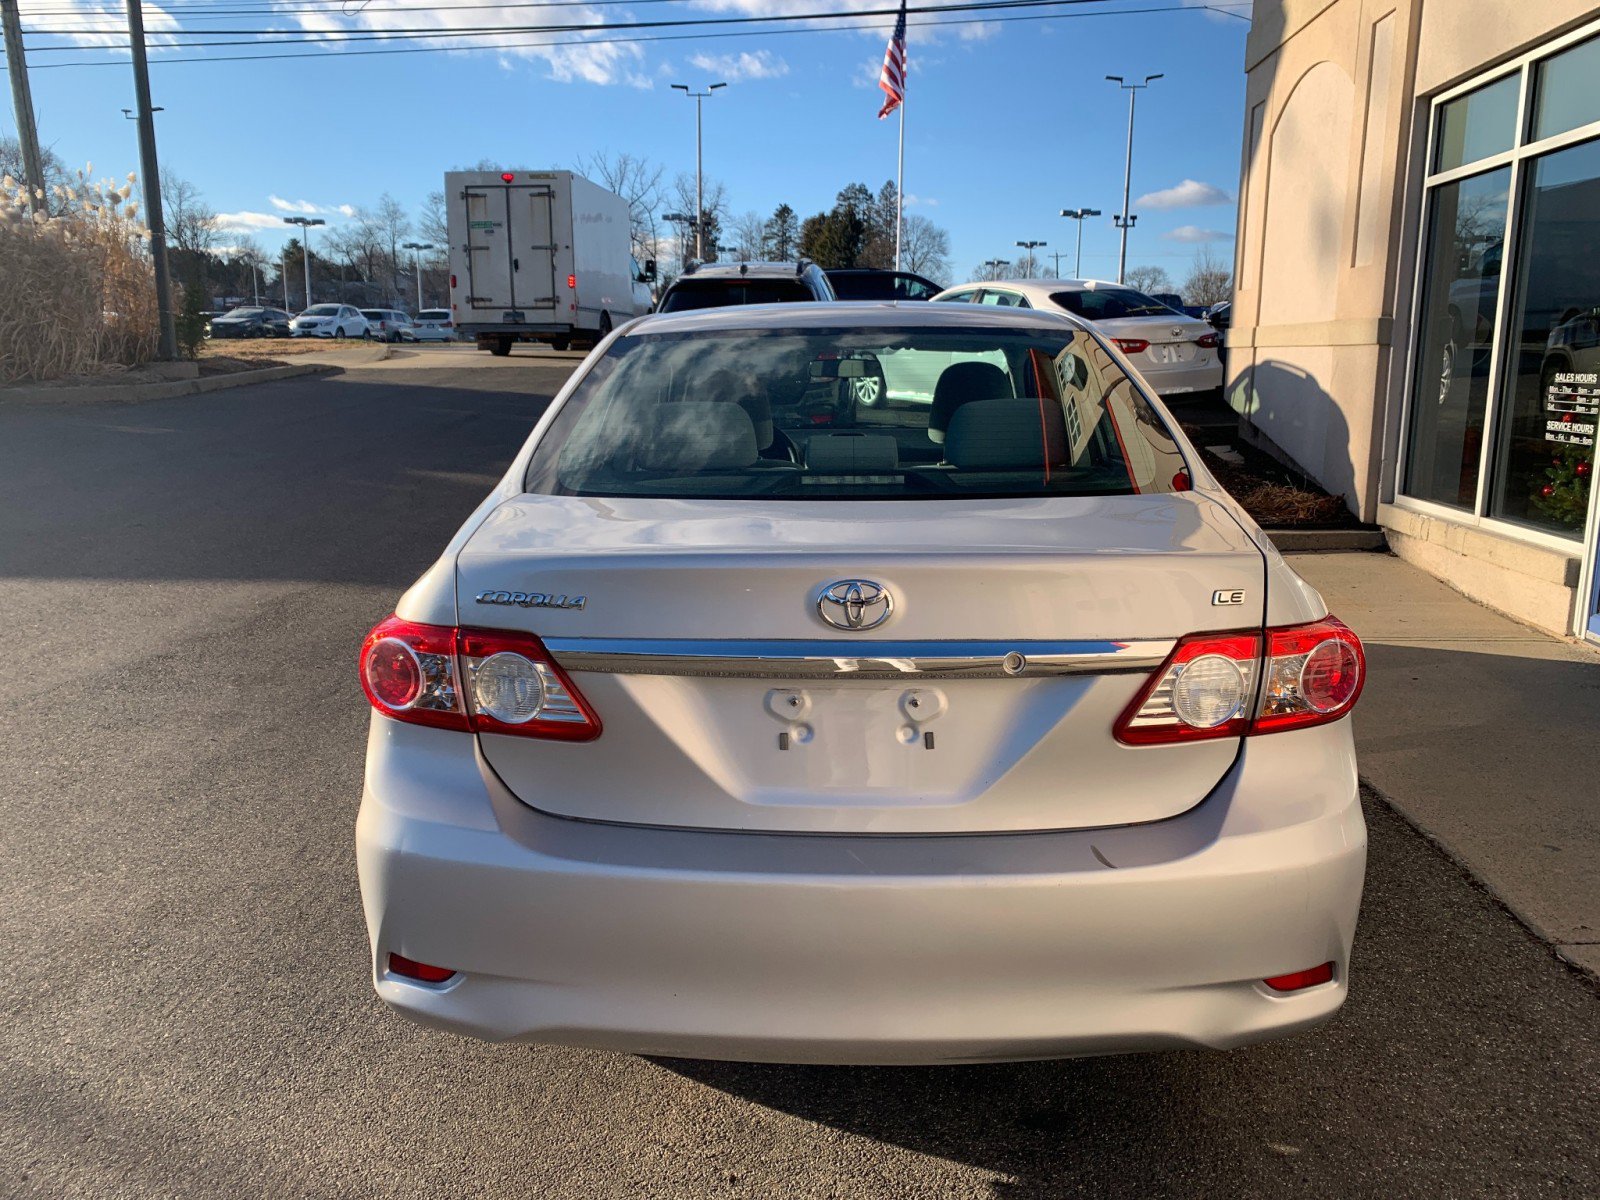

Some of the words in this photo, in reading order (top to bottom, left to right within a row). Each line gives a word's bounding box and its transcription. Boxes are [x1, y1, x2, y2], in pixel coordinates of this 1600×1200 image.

[1555, 373, 1575, 383] SALES
[1575, 374, 1597, 383] HOURS
[1547, 421, 1572, 431] SERVICE
[1572, 423, 1594, 434] HOURS
[475, 589, 588, 611] COROLLA
[1217, 591, 1244, 604] LE
